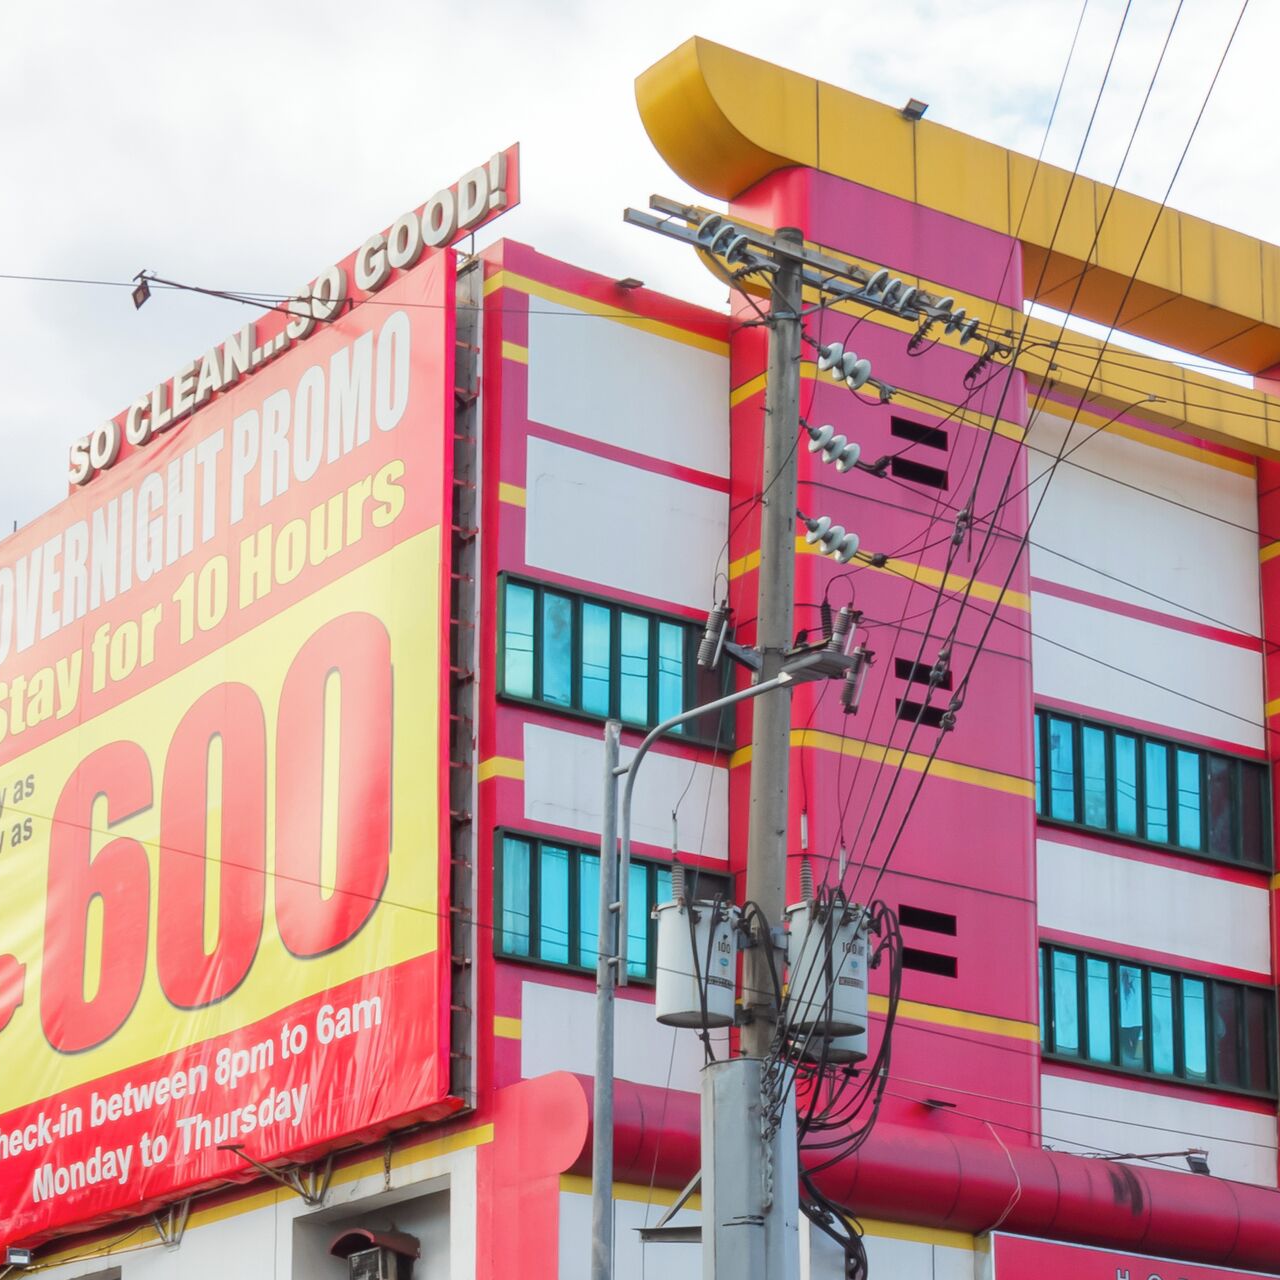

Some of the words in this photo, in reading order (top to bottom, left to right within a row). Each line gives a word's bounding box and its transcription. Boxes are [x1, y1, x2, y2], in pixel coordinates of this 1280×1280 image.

[69, 420, 120, 486] SO
[354, 152, 507, 292] GOOD!
[230, 310, 412, 526] PROMO
[91, 602, 162, 693] for
[173, 555, 228, 645] 10
[239, 458, 407, 609] Hours
[11, 815, 33, 847] as
[13, 773, 35, 804] as
[40, 611, 393, 1055] 600
[32, 1150, 131, 1203] Monday
[140, 1129, 168, 1169] to
[176, 1083, 309, 1156] Thursday
[90, 1063, 208, 1128] between
[214, 1036, 274, 1086] 8pm
[280, 1023, 308, 1061] to
[316, 995, 382, 1045] 6am
